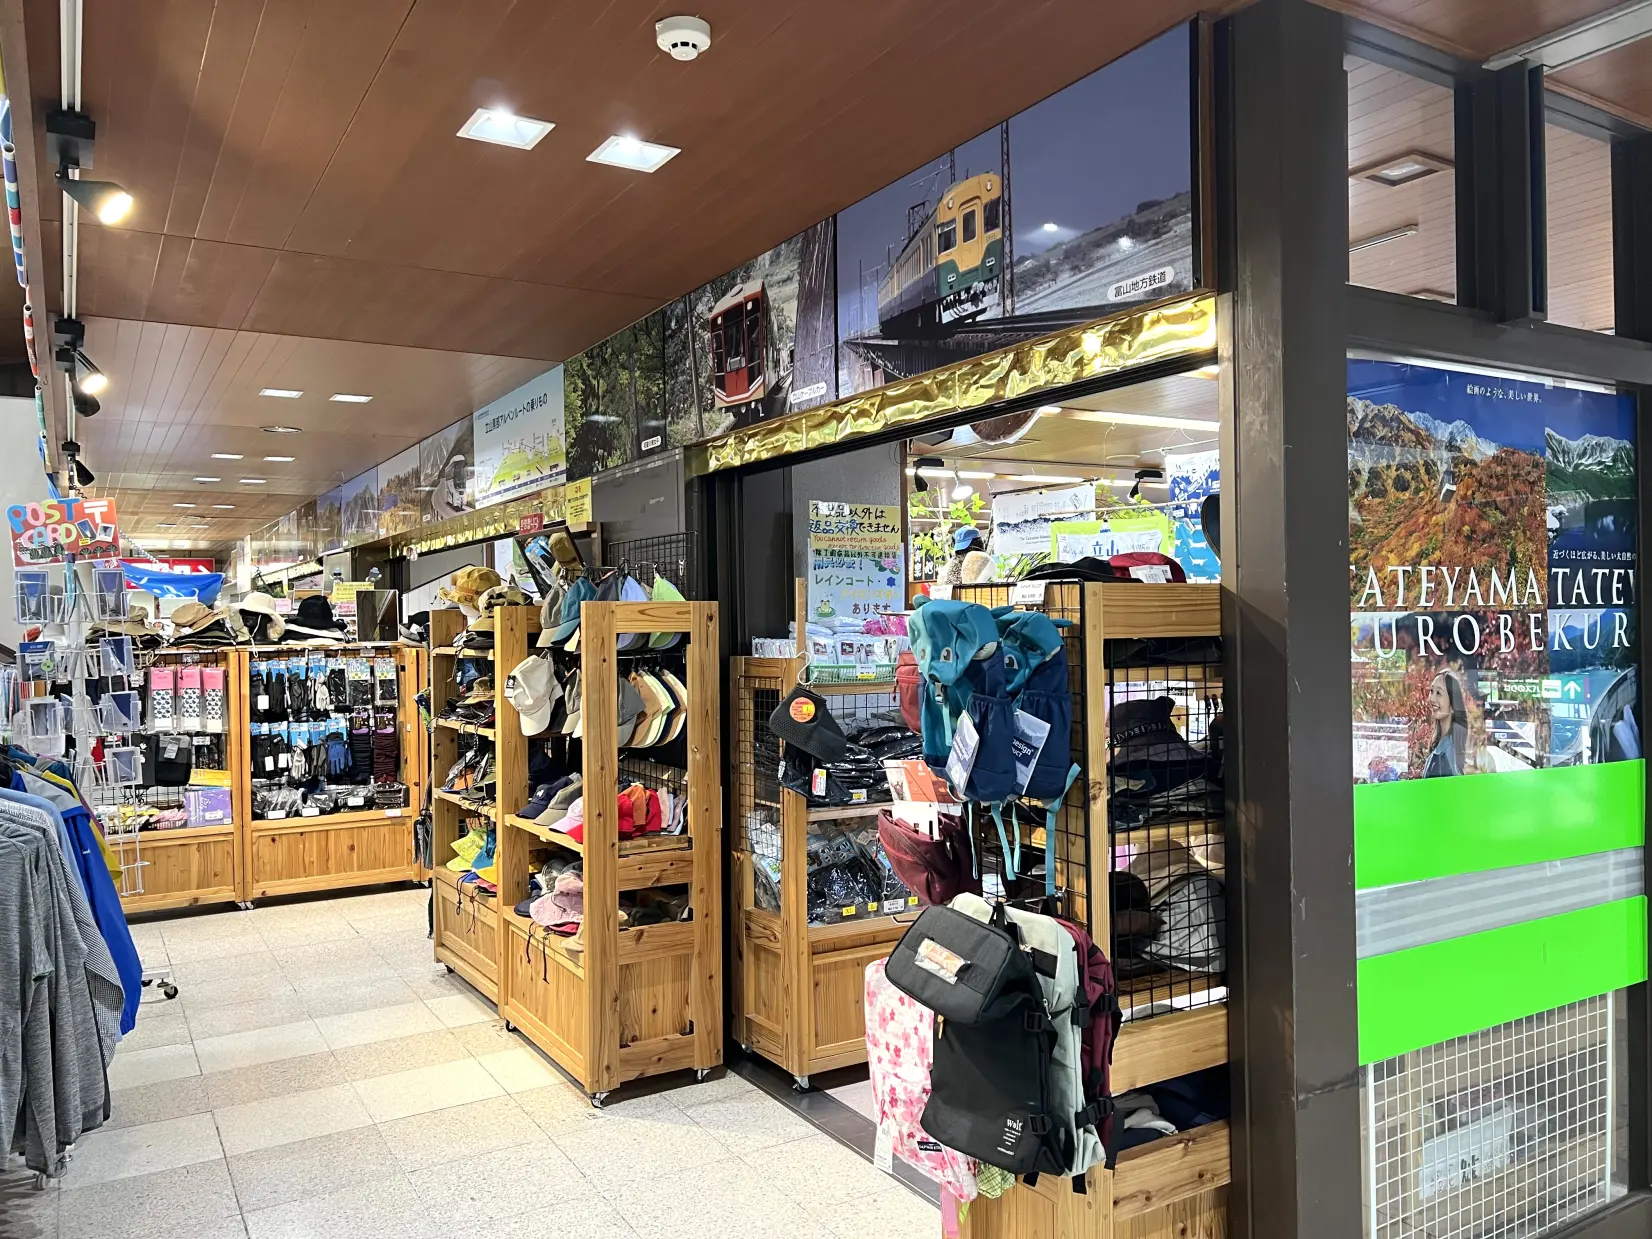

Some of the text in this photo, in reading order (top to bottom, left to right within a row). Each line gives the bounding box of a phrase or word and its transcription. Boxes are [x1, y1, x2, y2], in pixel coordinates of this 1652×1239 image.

[1114, 270, 1167, 298] 富山地方鉄道
[1466, 383, 1543, 404] 絵画のような、美しい世界。
[484, 392, 548, 434] 立山黒部アルペンルートの乗りもの
[6, 498, 81, 534] POST
[808, 518, 900, 536] 返品交換できません
[20, 522, 78, 548] CARD
[1092, 539, 1119, 557] 立山
[1552, 549, 1637, 561] 近づくほど広がる、美しい大自然の
[1351, 613, 1544, 659] UROBE
